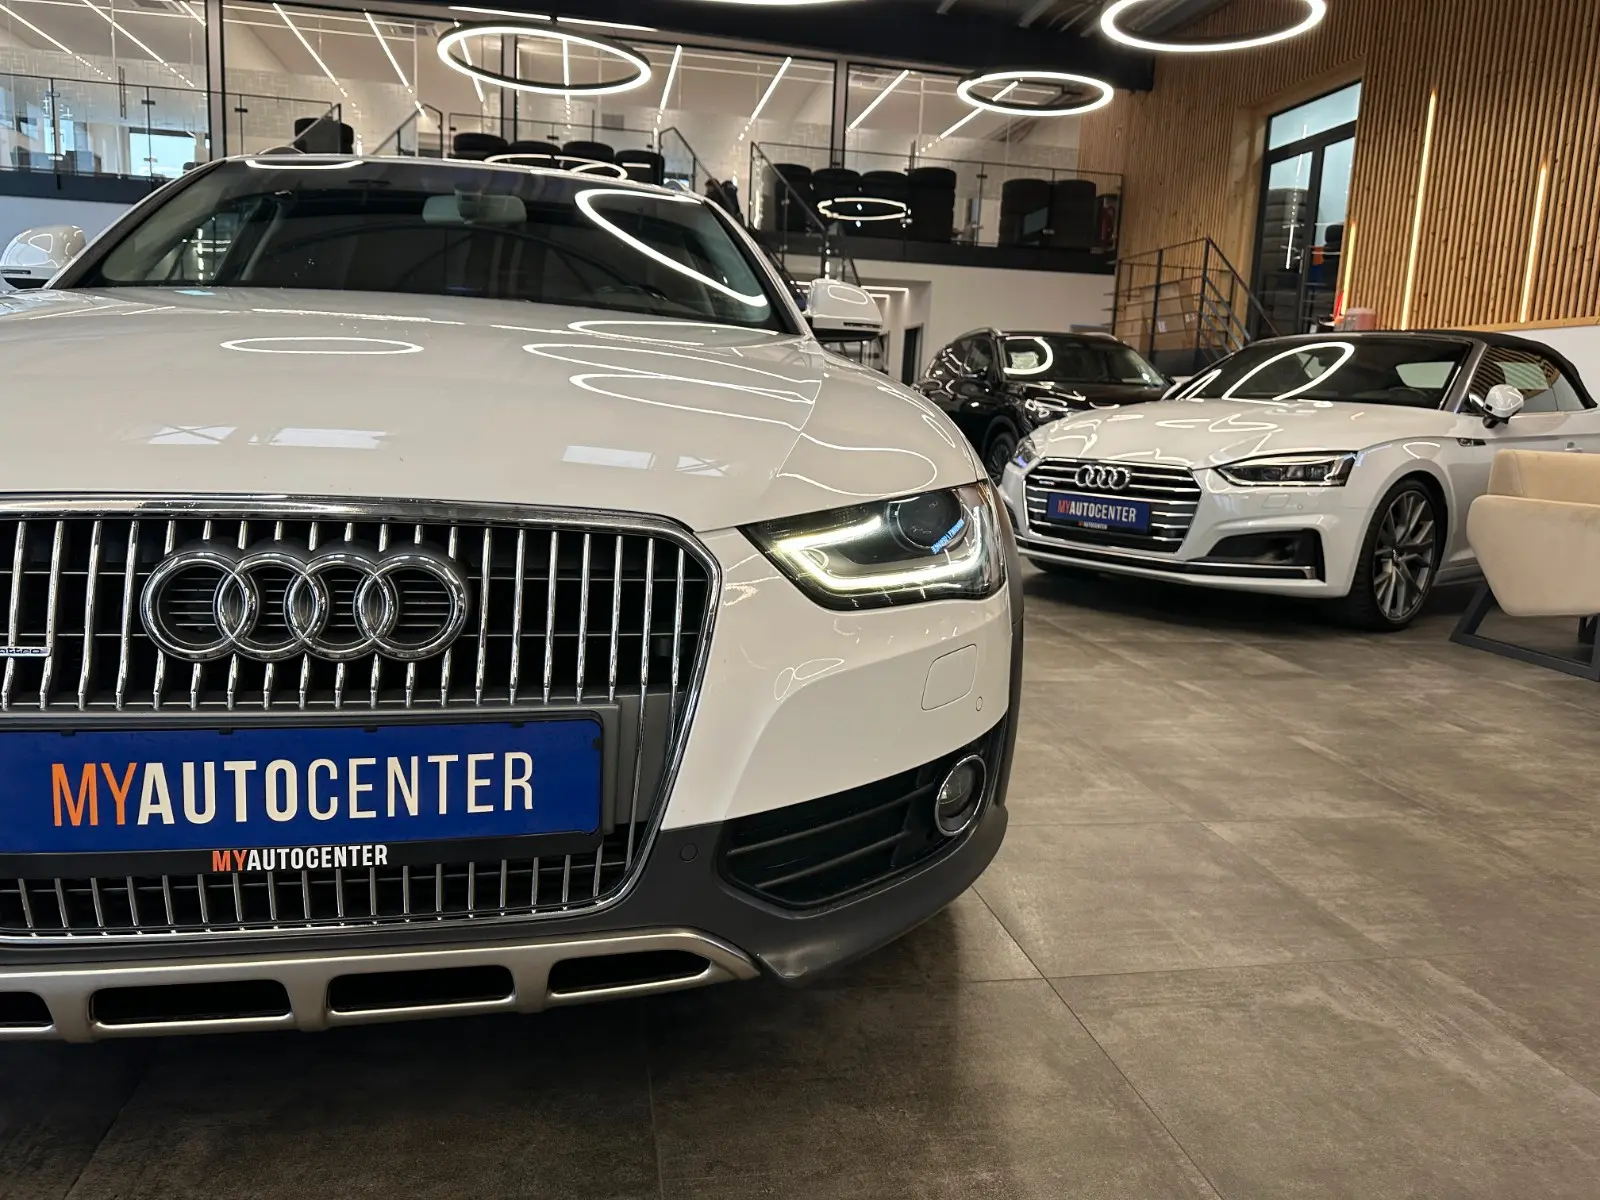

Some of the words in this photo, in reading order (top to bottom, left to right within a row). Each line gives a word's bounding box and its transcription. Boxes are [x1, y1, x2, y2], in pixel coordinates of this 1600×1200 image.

[1057, 500, 1137, 523] MYAUTOCENTER
[52, 751, 534, 827] MYAUTOCENTER
[212, 844, 388, 872] MYAUTOCENTER
